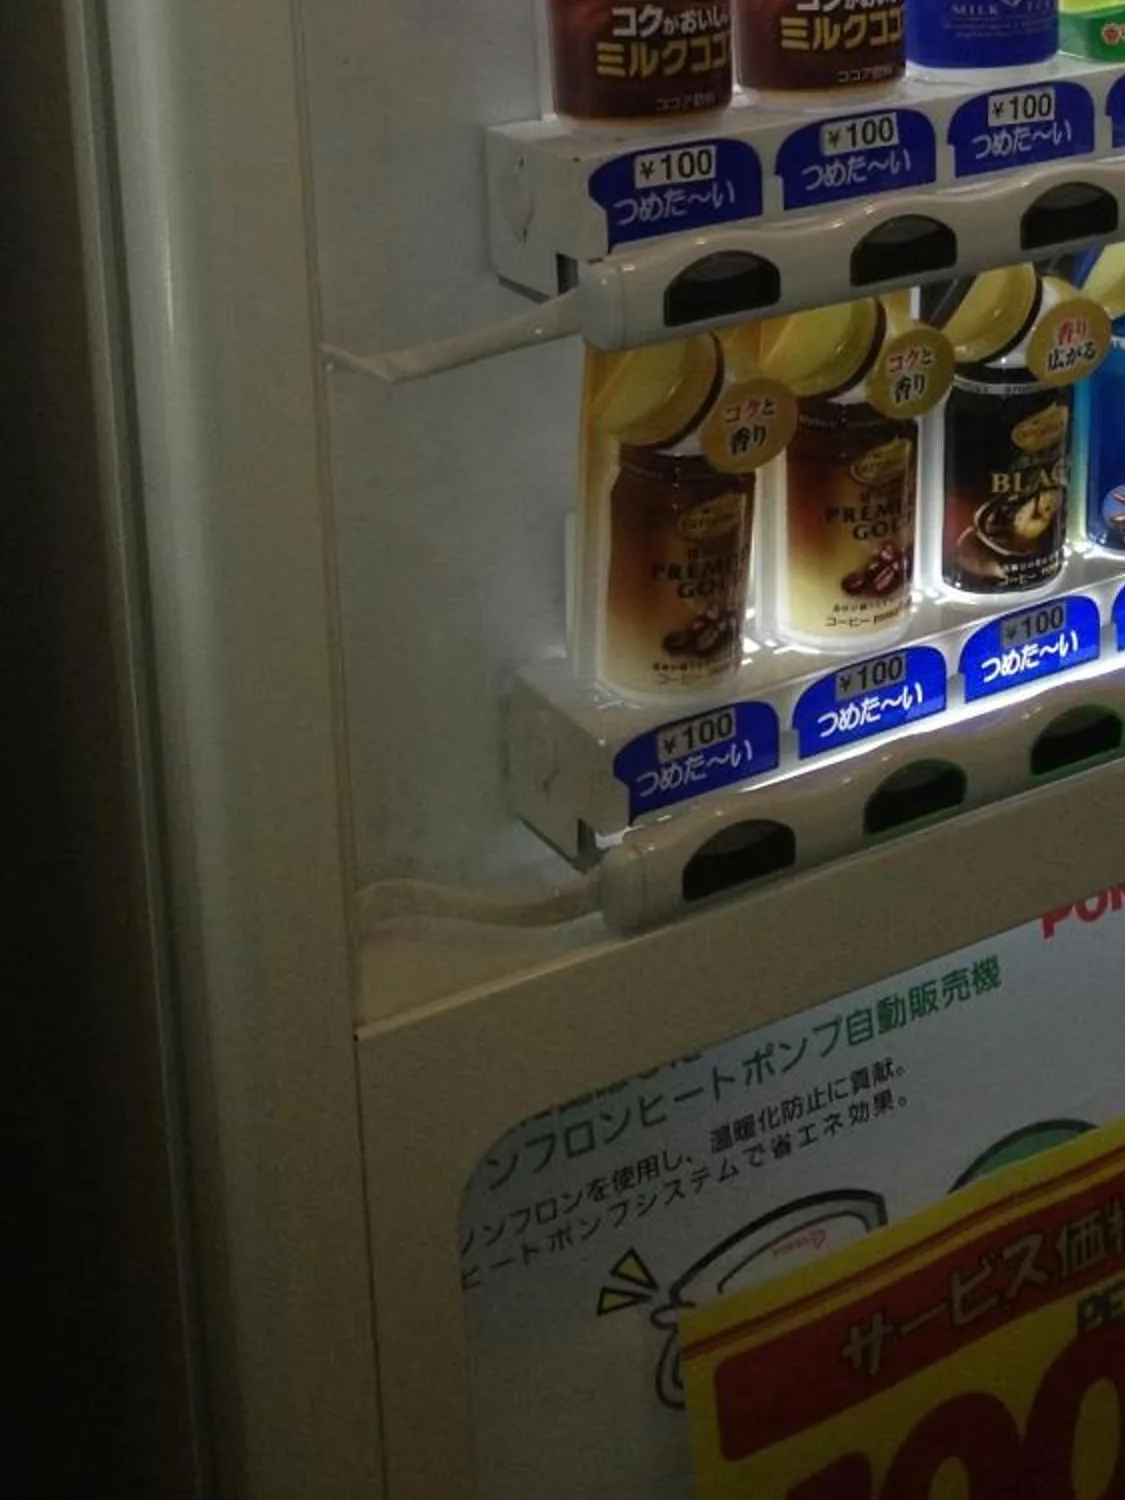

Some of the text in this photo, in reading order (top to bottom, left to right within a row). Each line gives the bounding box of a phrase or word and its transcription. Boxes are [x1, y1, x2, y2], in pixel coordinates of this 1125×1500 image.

[991, 92, 1053, 122] ¥100
[827, 117, 895, 148] ¥100
[639, 149, 713, 180] ¥100
[889, 346, 936, 373] コクと
[895, 375, 926, 404] 香り
[725, 395, 777, 424] コクと
[730, 424, 768, 455] 香り
[1007, 605, 1065, 640] ¥100
[839, 656, 904, 692] ¥100
[664, 716, 733, 754] ¥100
